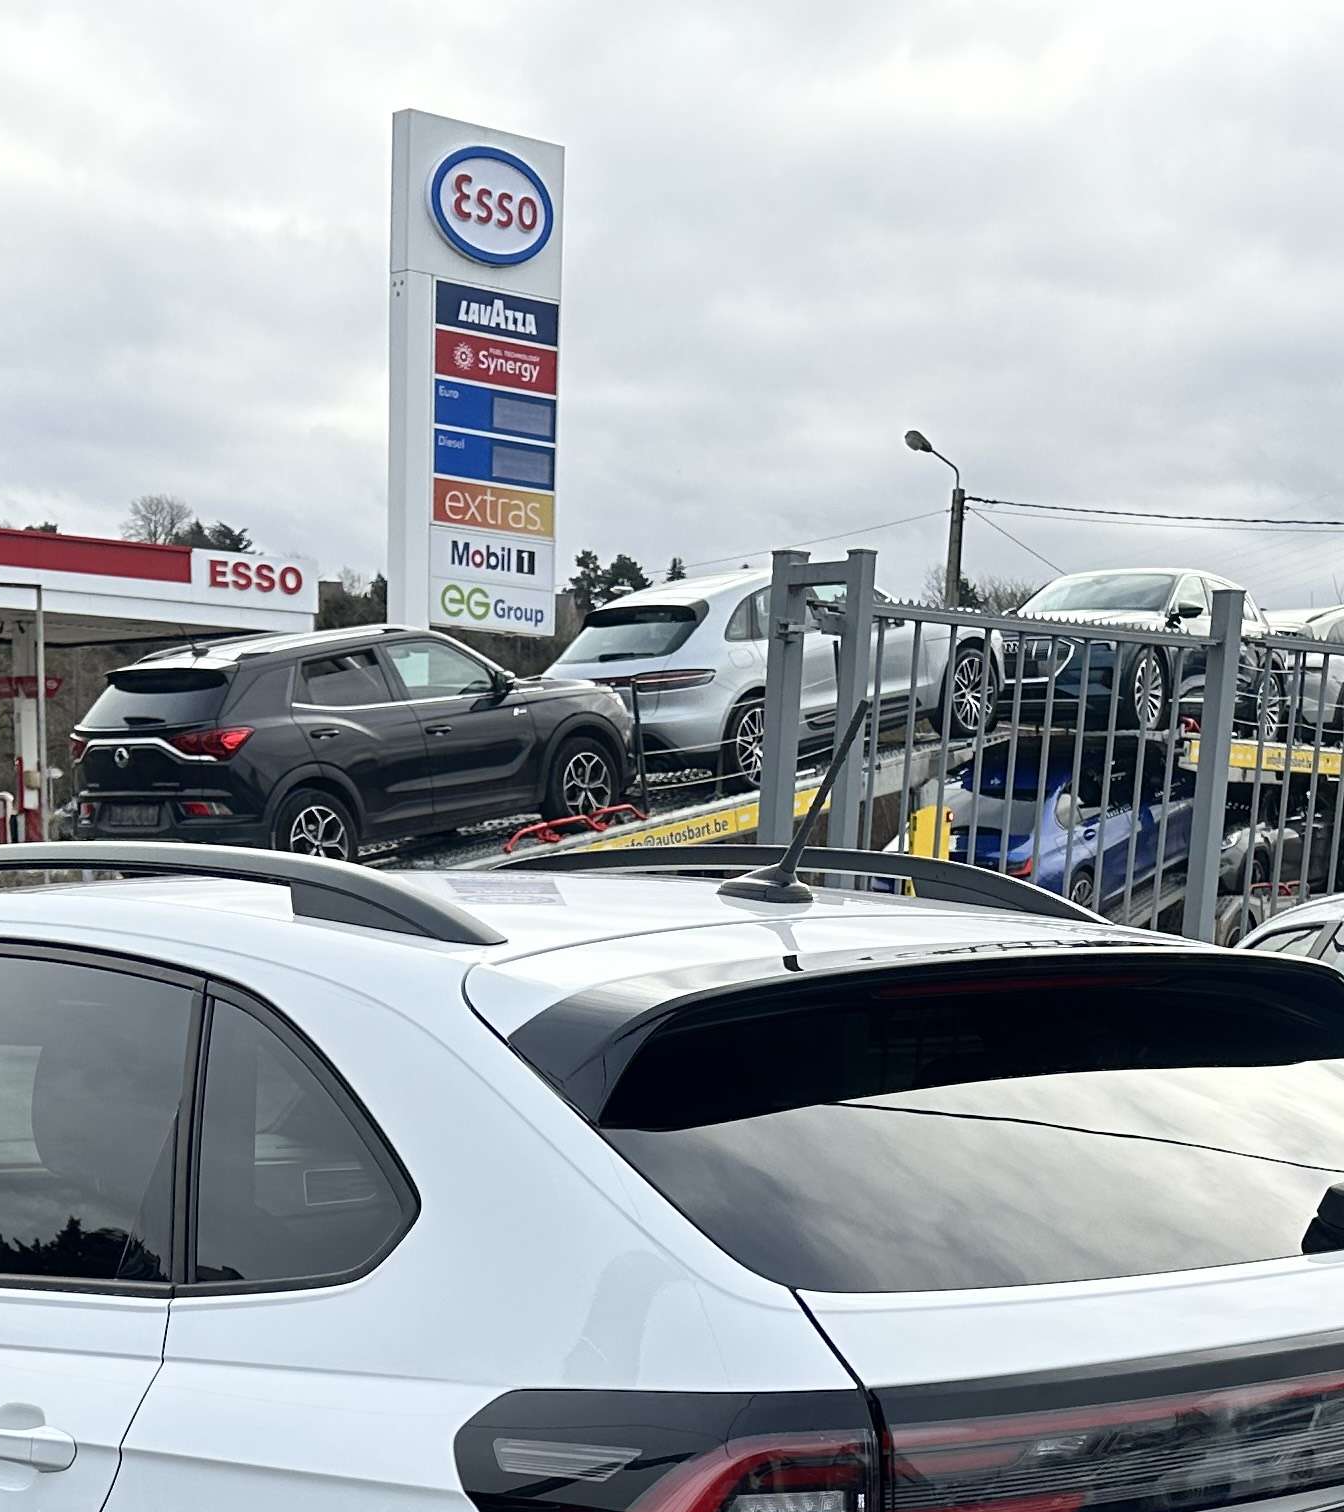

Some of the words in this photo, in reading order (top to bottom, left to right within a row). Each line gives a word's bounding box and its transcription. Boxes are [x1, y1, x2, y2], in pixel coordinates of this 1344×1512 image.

[458, 299, 538, 335] LAVAZZA
[478, 350, 540, 383] Synergy
[438, 385, 459, 399] Euro
[438, 435, 465, 450] Diesel
[451, 540, 511, 572] Mobil
[209, 560, 302, 595] ESSO
[494, 599, 544, 627] Group
